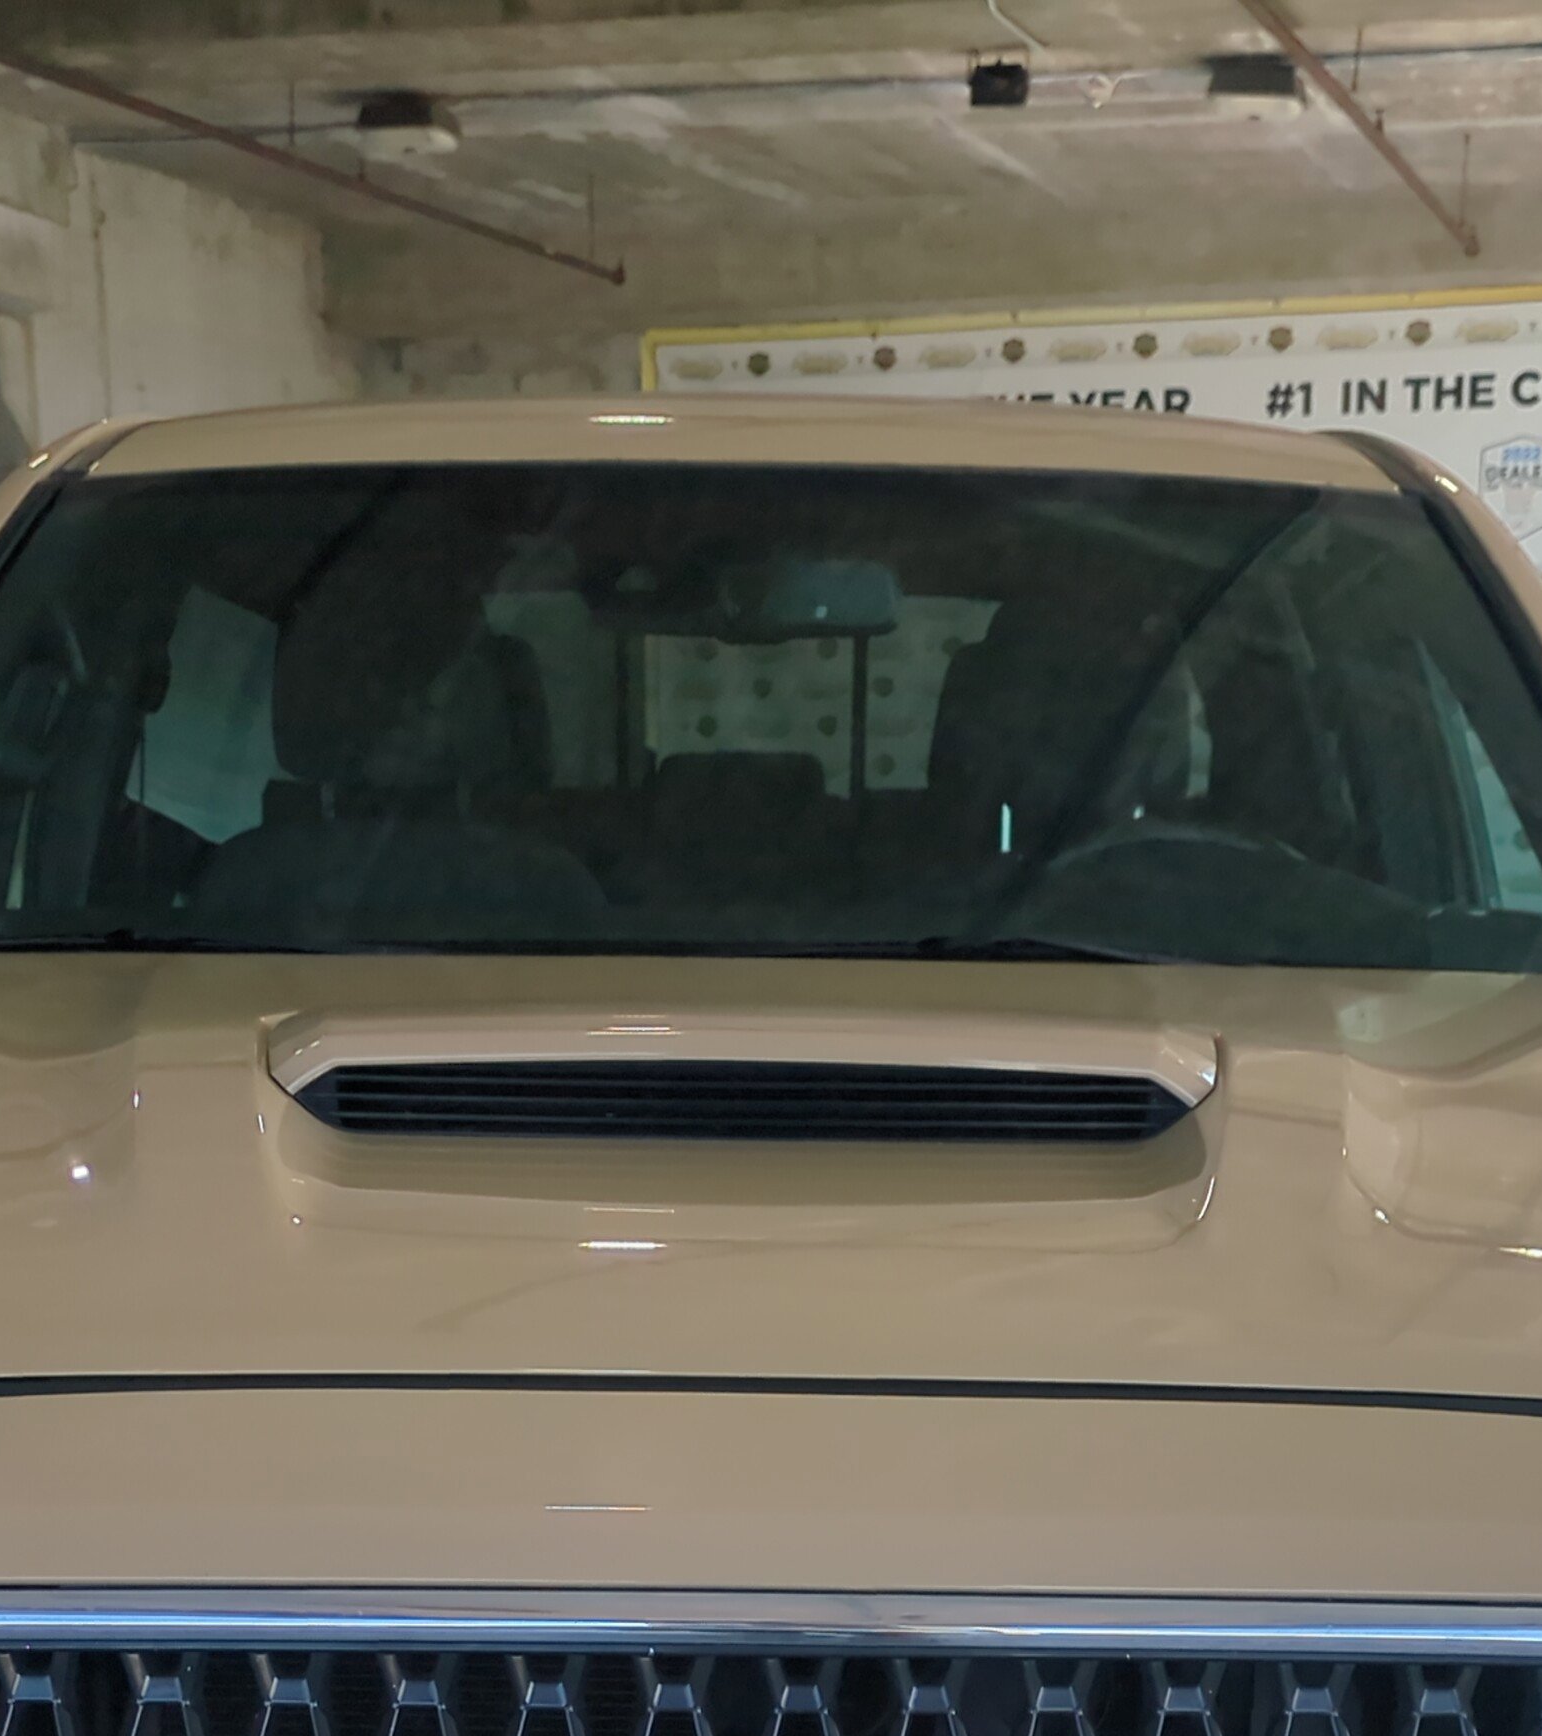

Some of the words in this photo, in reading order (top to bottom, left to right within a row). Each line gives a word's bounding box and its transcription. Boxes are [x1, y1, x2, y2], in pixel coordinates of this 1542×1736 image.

[1265, 381, 1313, 418] #1
[1341, 378, 1387, 415] IN
[1403, 374, 1496, 411] THE
